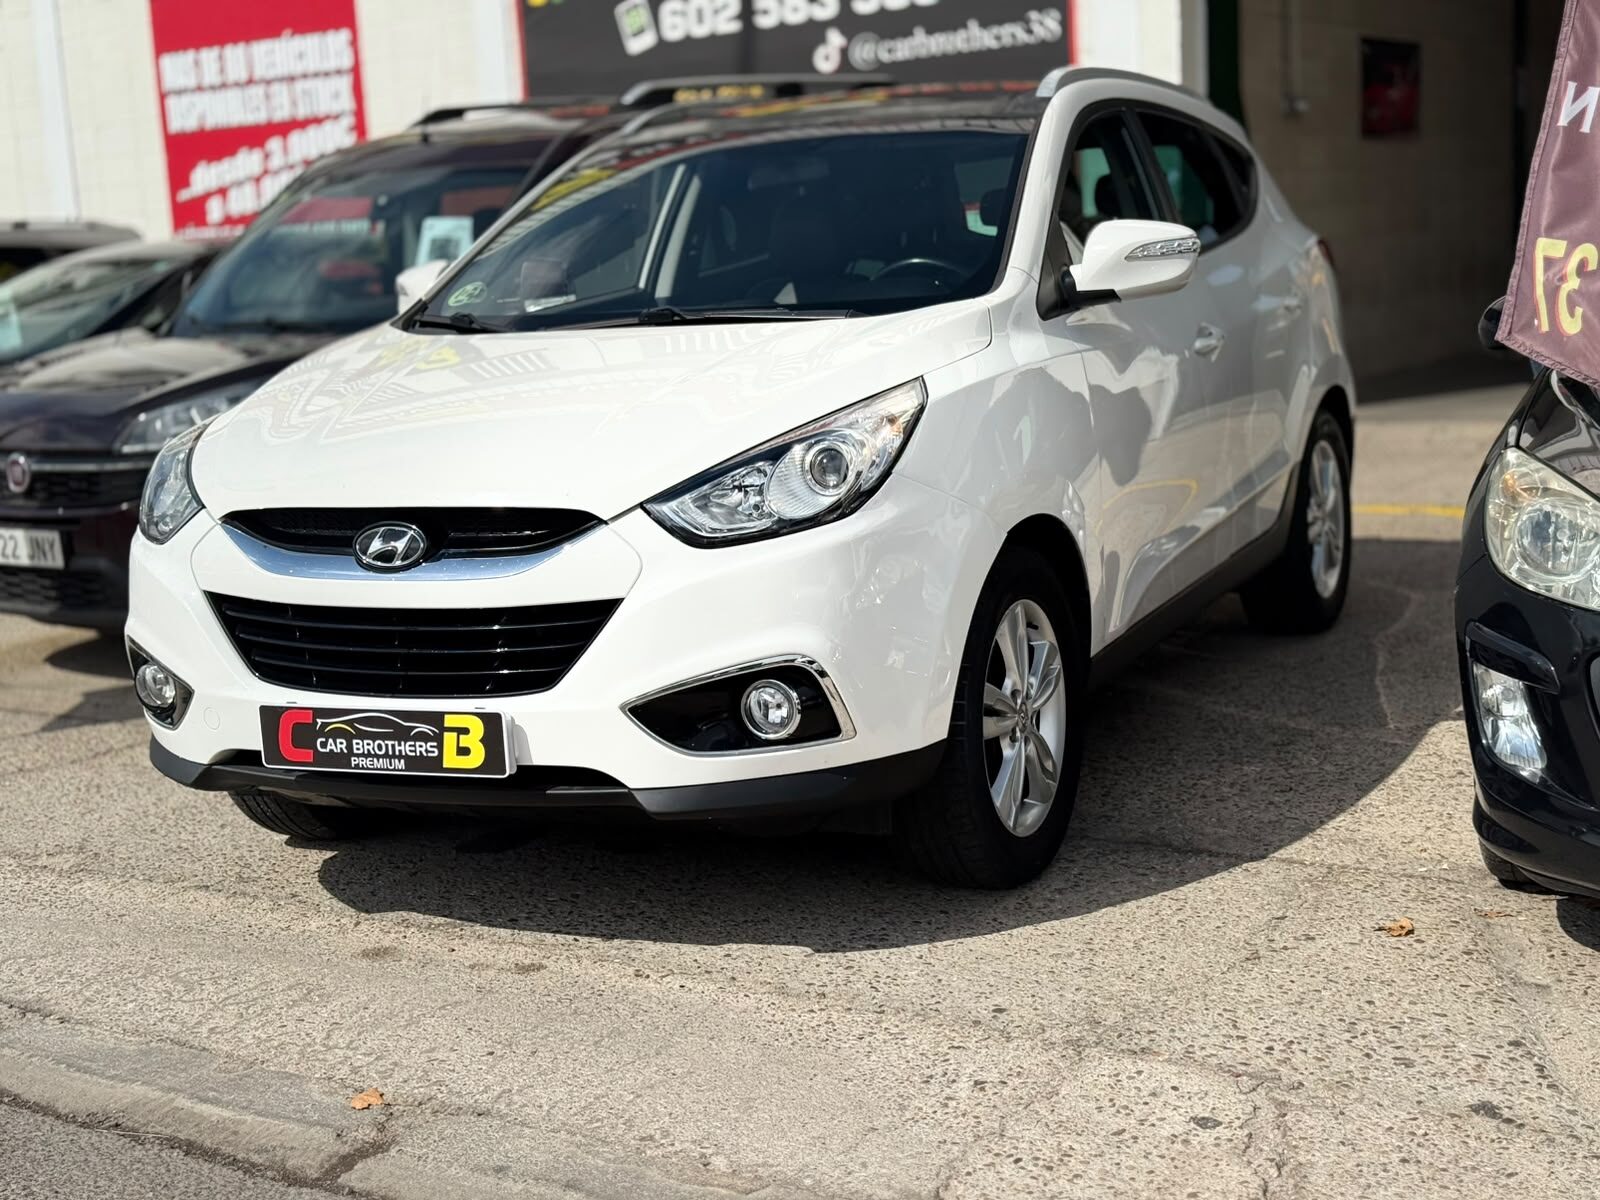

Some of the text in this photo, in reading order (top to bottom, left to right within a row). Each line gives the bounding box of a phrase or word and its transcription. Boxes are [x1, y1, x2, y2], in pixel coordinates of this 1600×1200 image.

[658, 0, 743, 41] 602
[28, 535, 57, 562] JNY
[278, 709, 314, 762] C
[316, 738, 439, 757] CAR BROTHERS
[351, 757, 405, 770] PREMIUM
